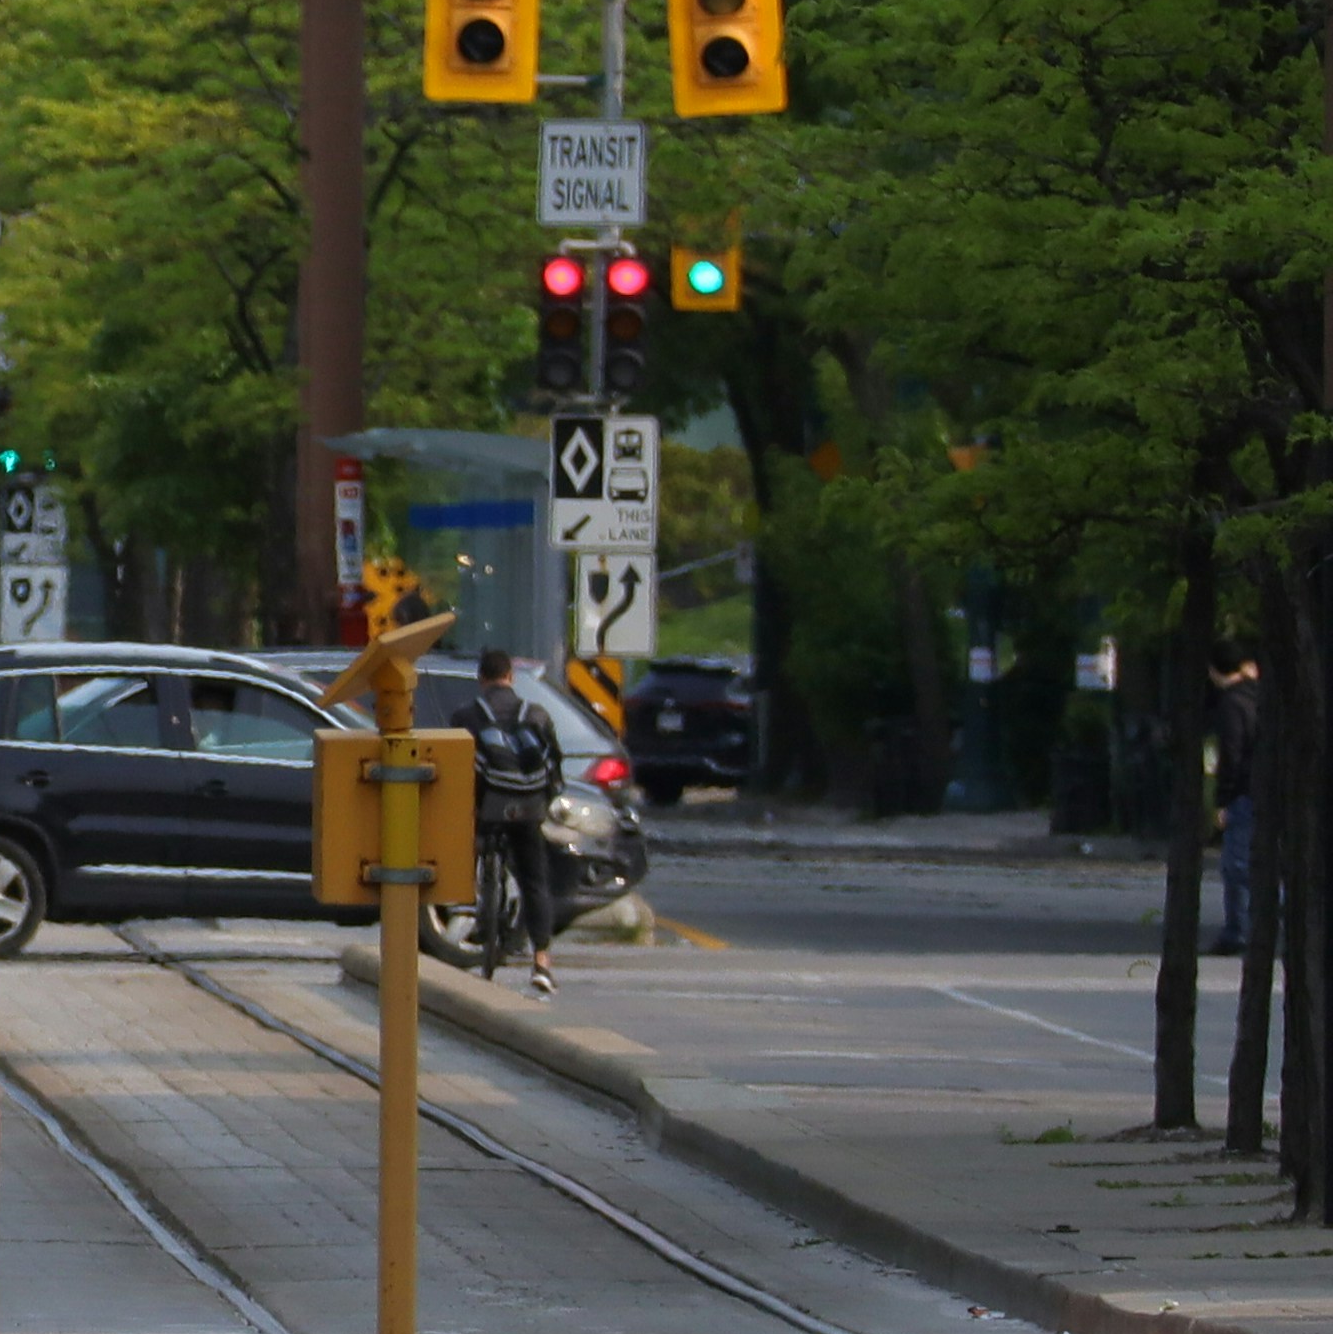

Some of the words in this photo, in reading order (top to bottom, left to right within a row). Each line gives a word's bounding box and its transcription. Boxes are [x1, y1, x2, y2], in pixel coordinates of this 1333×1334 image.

[548, 135, 636, 169] TRANSIT
[551, 178, 630, 211] SIGNAL
[617, 507, 651, 523] THIS
[608, 527, 650, 541] LANE
